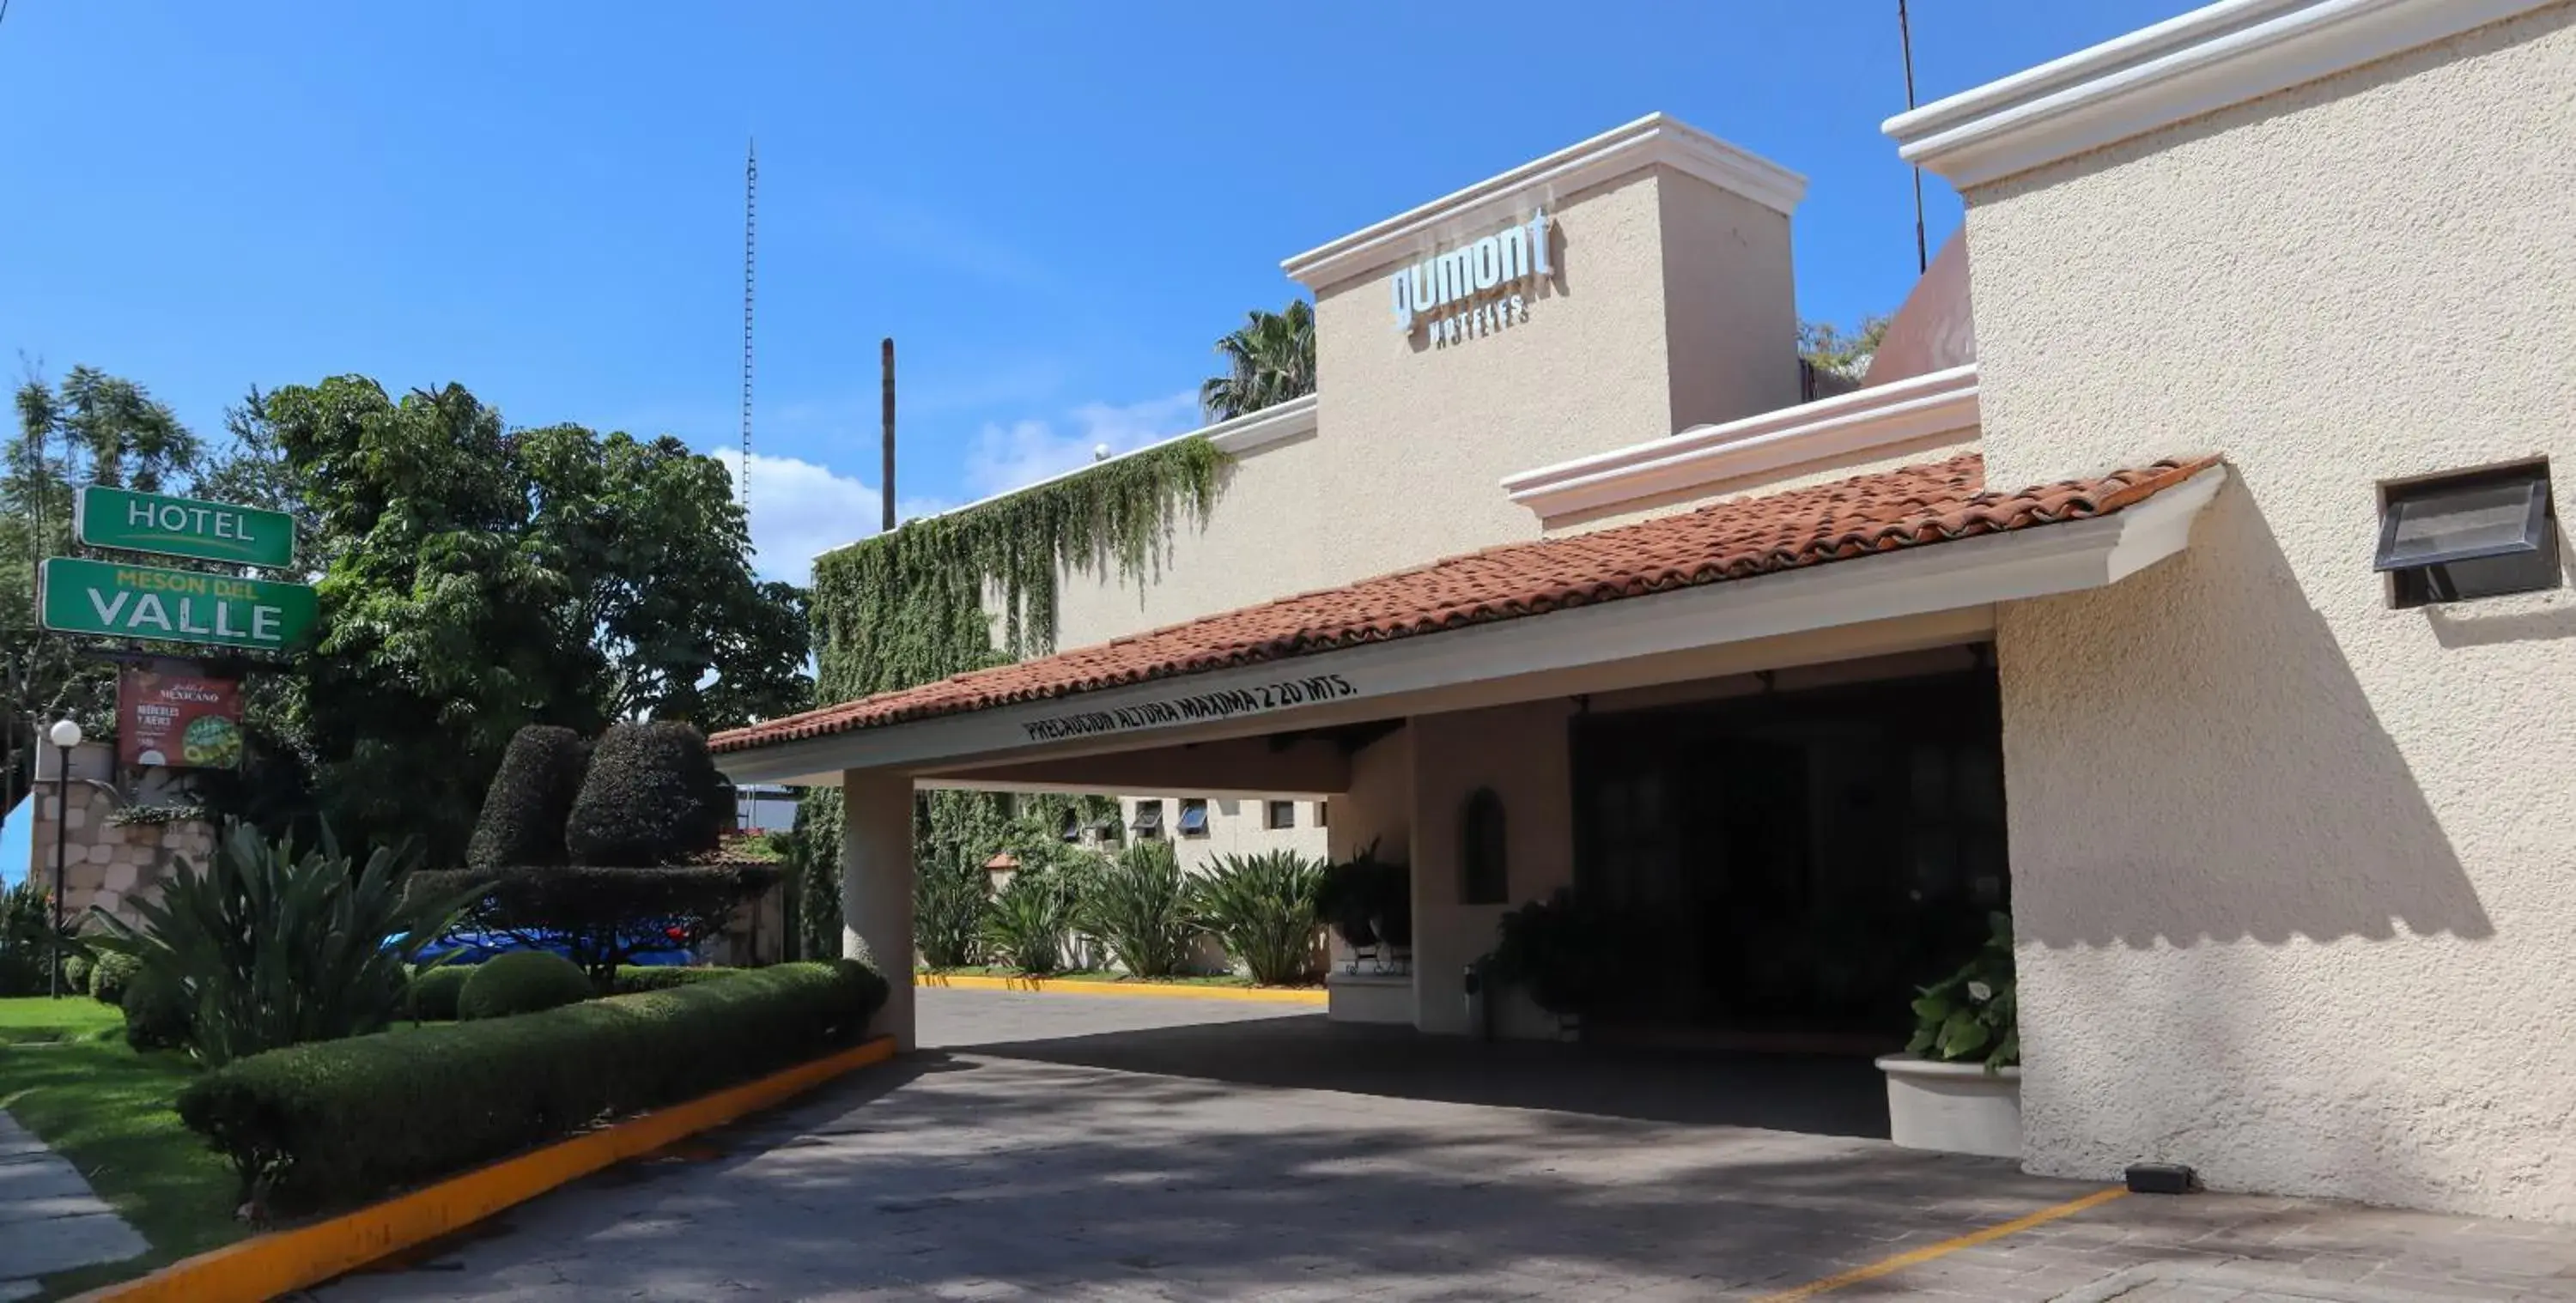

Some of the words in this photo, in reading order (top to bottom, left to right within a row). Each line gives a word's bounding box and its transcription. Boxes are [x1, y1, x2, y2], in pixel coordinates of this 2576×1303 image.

[1428, 294, 1524, 345] HOTELES
[129, 500, 255, 542] HOTEL
[117, 569, 205, 595] MESON
[215, 579, 258, 599] DEL
[88, 587, 283, 641] VALLE
[160, 689, 220, 703] MEXICANO
[1023, 710, 1116, 741] PRECAUCION
[1114, 700, 1182, 729] ALTURA
[1174, 689, 1259, 720] MAXIMA
[1298, 674, 1358, 701] MTS.
